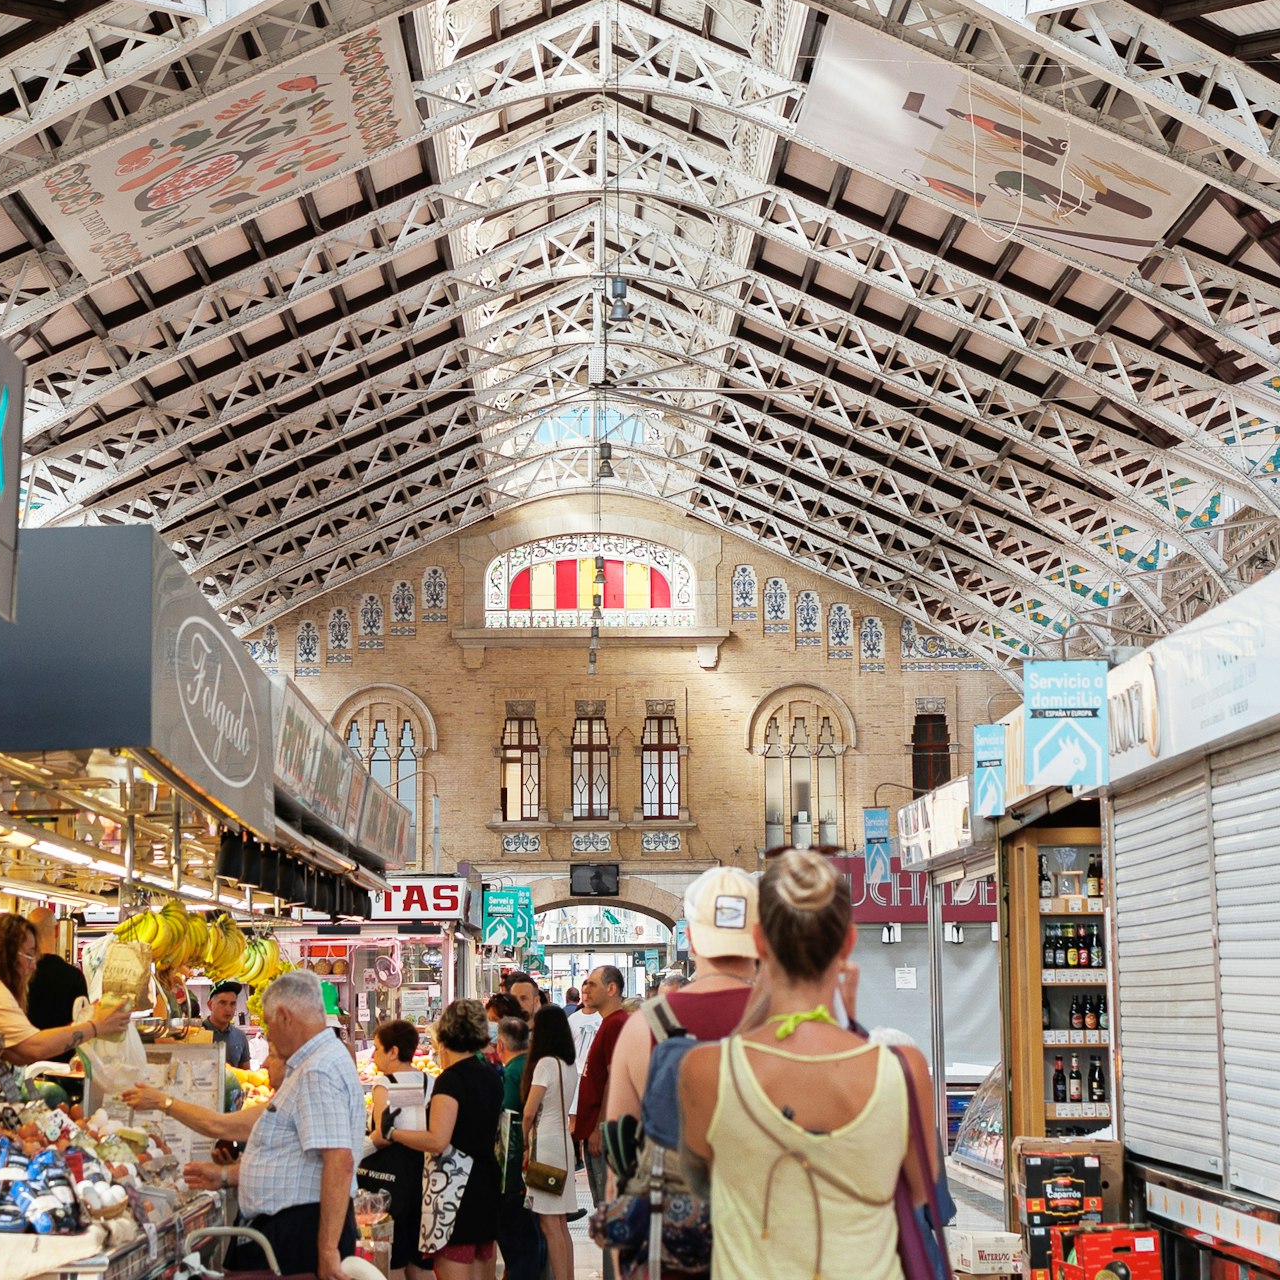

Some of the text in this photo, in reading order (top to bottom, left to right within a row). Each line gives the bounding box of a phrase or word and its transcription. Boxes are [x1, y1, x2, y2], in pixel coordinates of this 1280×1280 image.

[1029, 672, 1103, 689] Servicio a
[187, 632, 250, 763] Folgado
[1031, 692, 1102, 708] domicilio
[1045, 708, 1066, 718] ESPAÑA
[1071, 709, 1093, 717] EUROPA
[976, 734, 998, 747] Servicio
[488, 896, 507, 905] Servei
[488, 904, 514, 914] domicili
[1047, 1191, 1081, 1199] Caparrós
